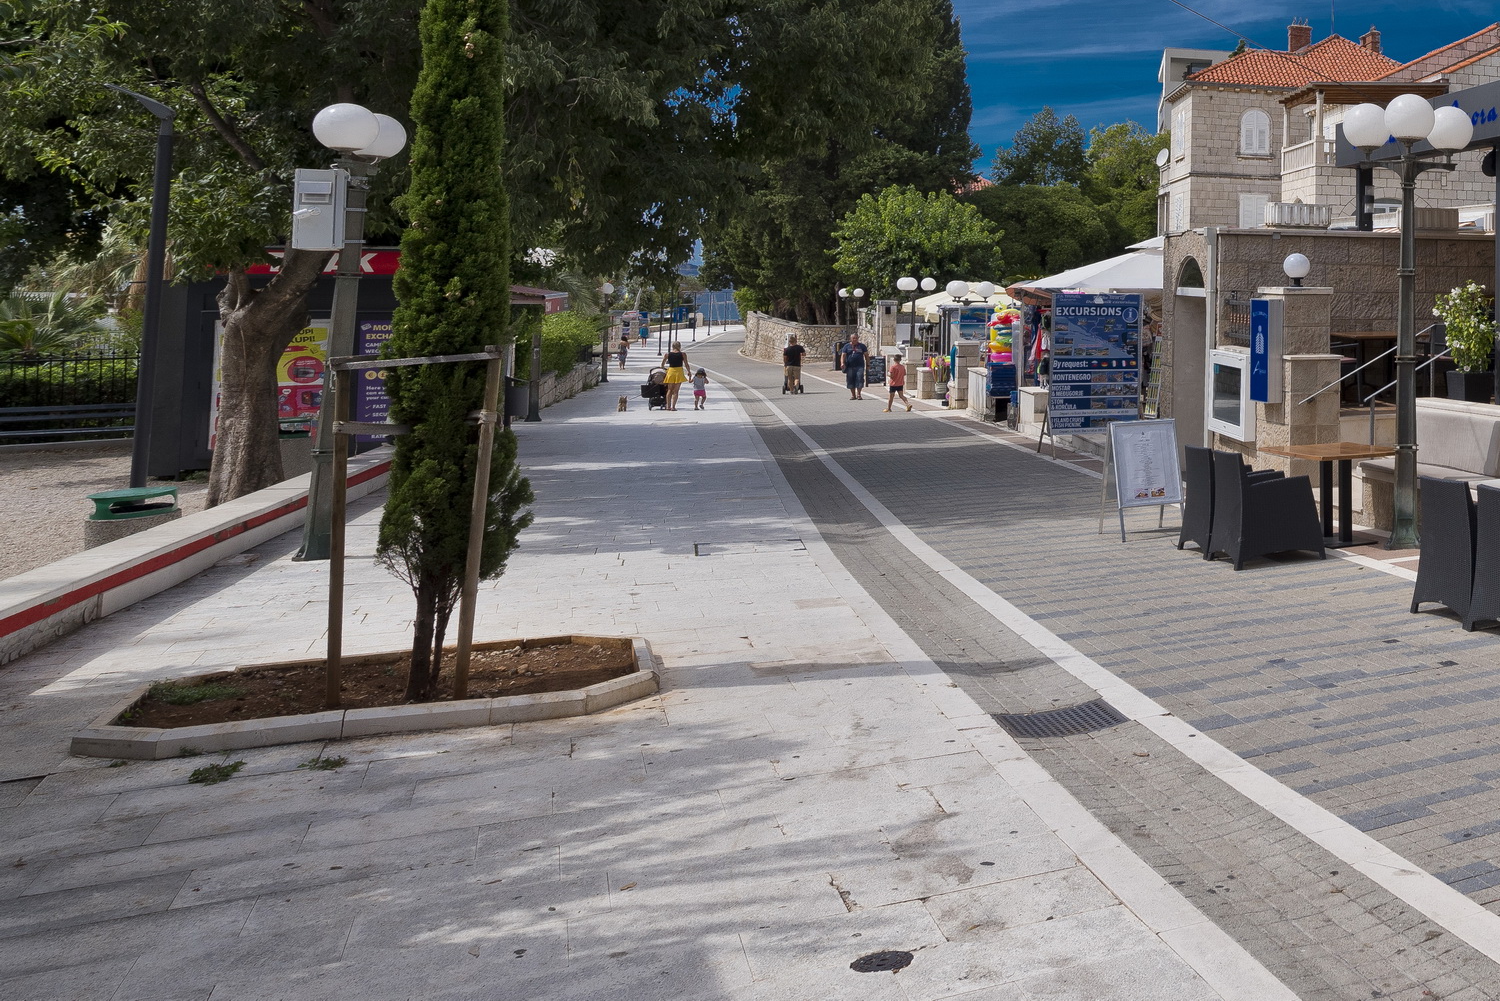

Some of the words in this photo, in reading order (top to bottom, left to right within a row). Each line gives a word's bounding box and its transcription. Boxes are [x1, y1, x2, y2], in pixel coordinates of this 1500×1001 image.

[1055, 306, 1122, 316] EXCURSIONS
[1053, 359, 1062, 369] By
[1061, 360, 1089, 369] request:
[1052, 373, 1092, 381] MONTENEGRO
